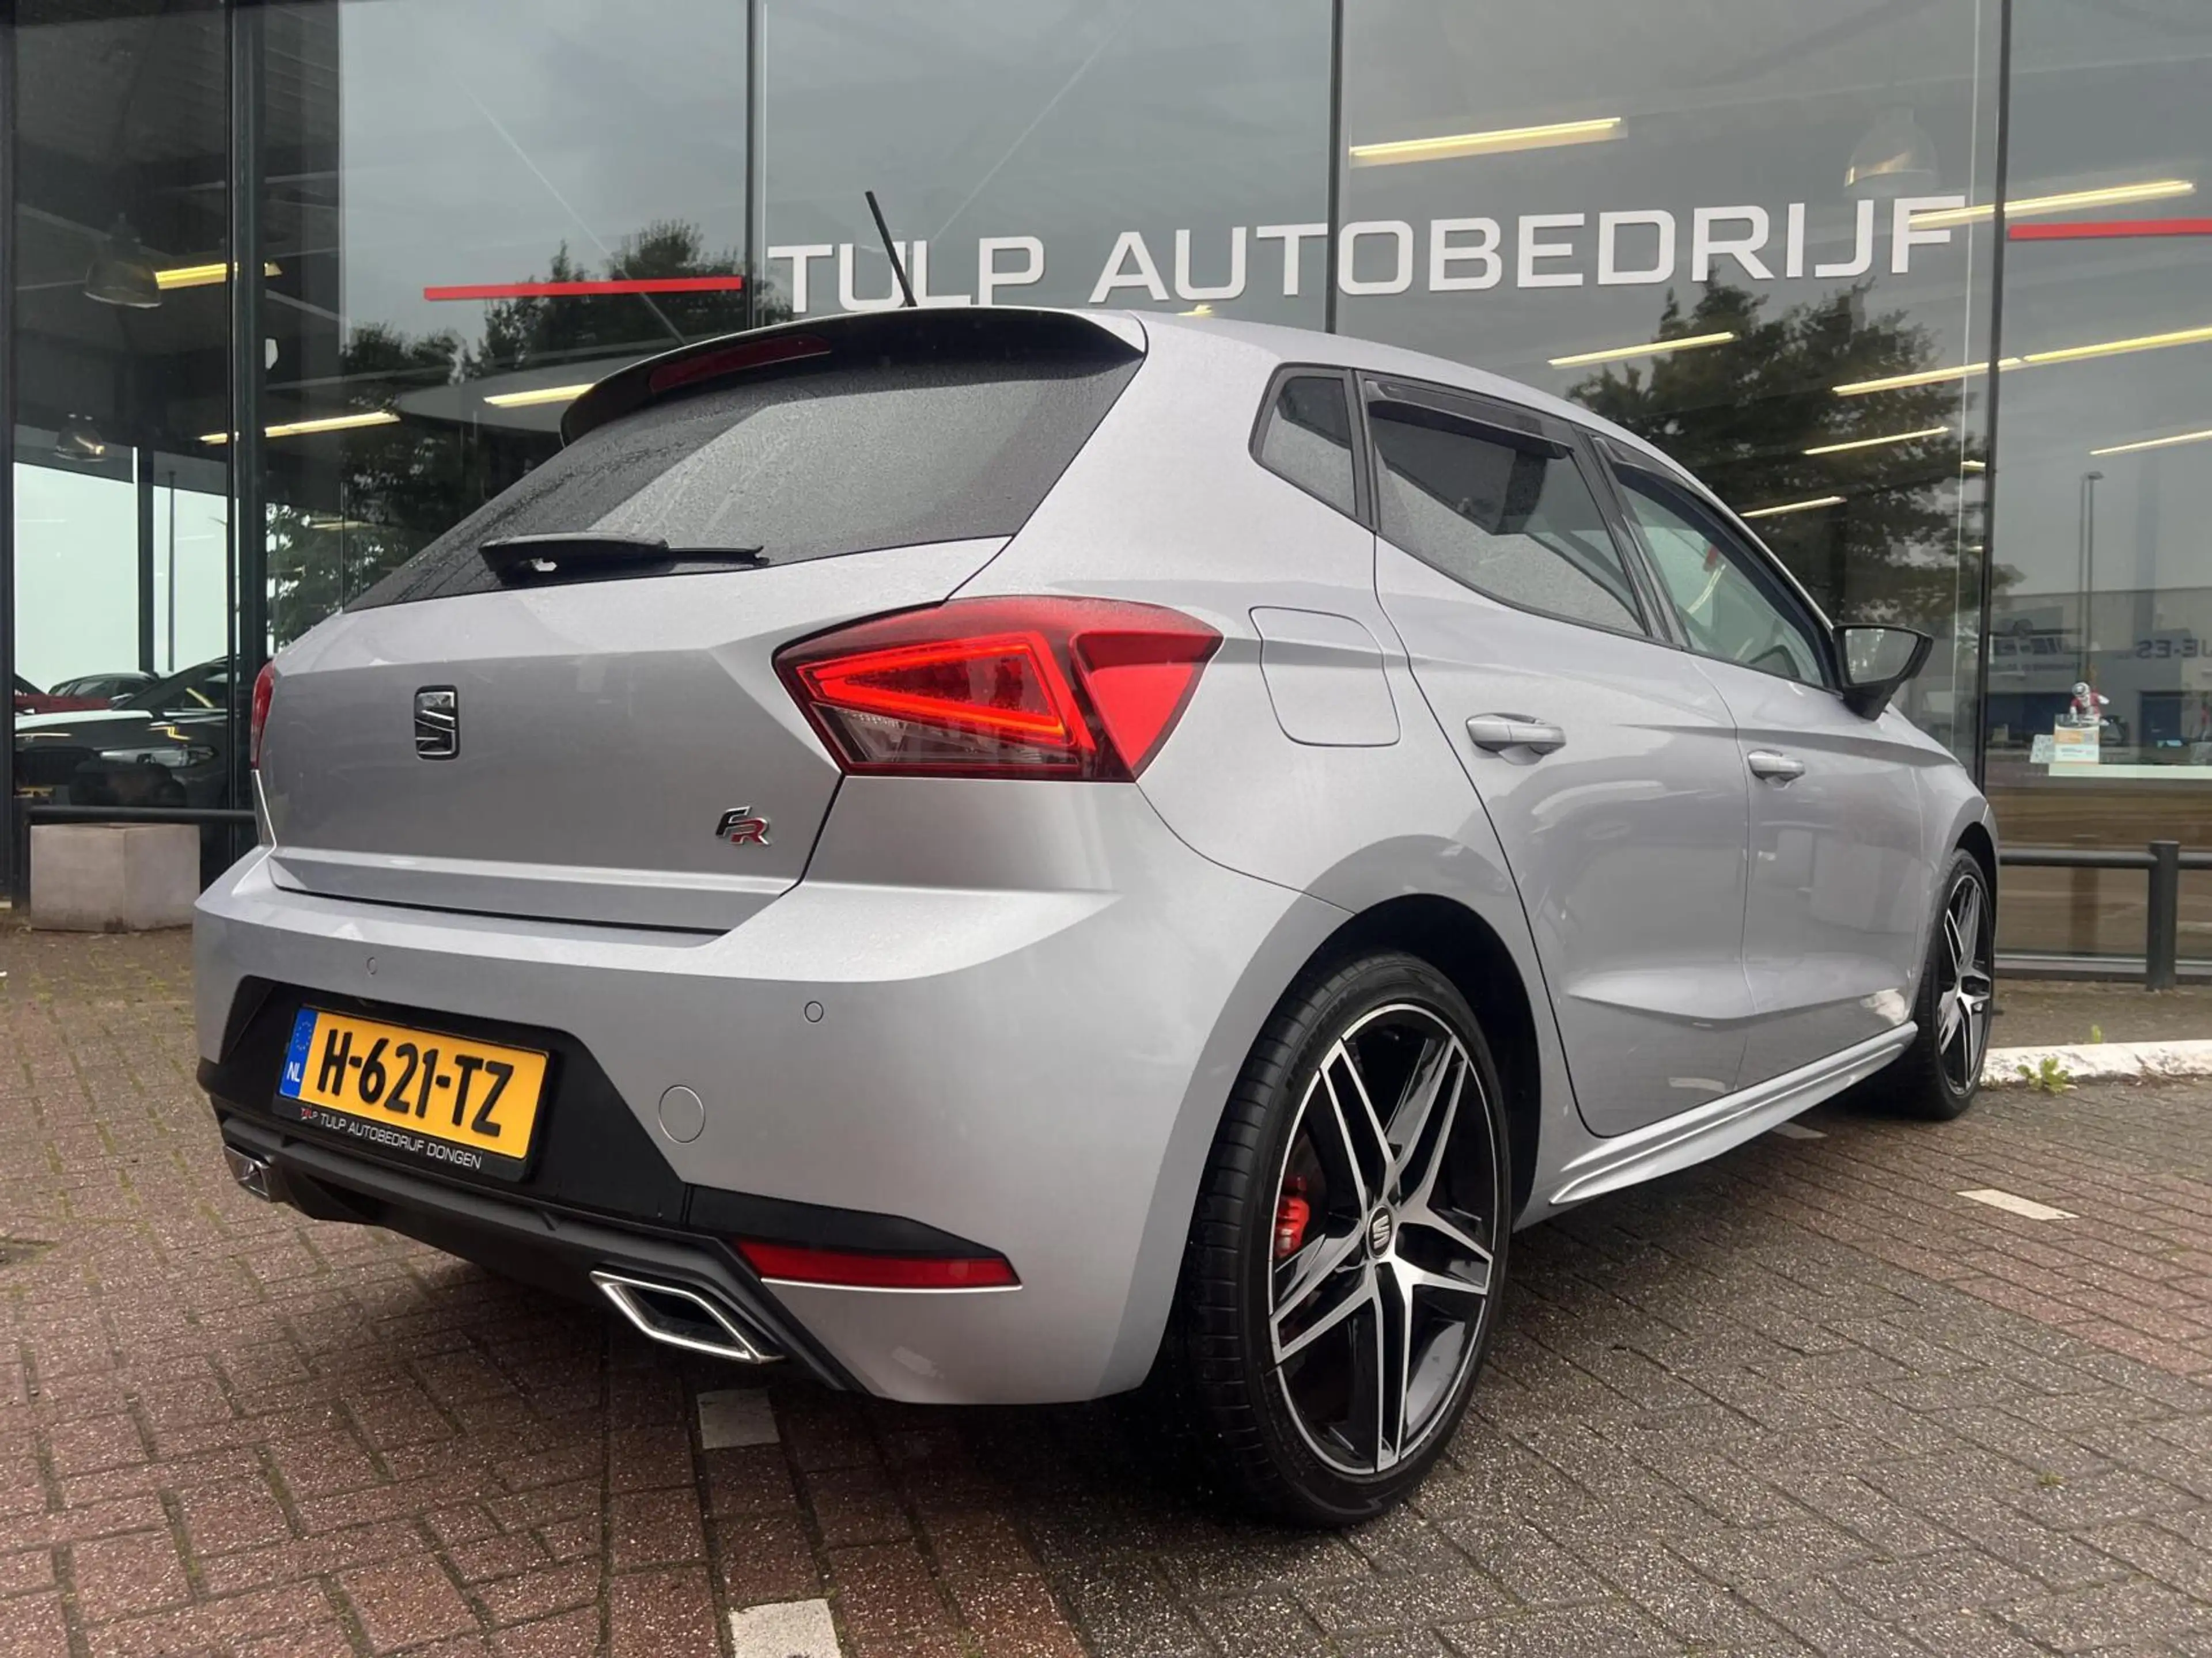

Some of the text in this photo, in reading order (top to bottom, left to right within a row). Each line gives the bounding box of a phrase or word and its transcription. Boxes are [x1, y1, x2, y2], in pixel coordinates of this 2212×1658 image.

[767, 195, 1967, 314] TULP AUTOBEDRIJF
[715, 806, 770, 845] FR
[286, 1061, 300, 1083] NL
[317, 1029, 514, 1137] H-621-TZ
[320, 1112, 482, 1170] TULP AUTOBEDRIJF DONGEN
